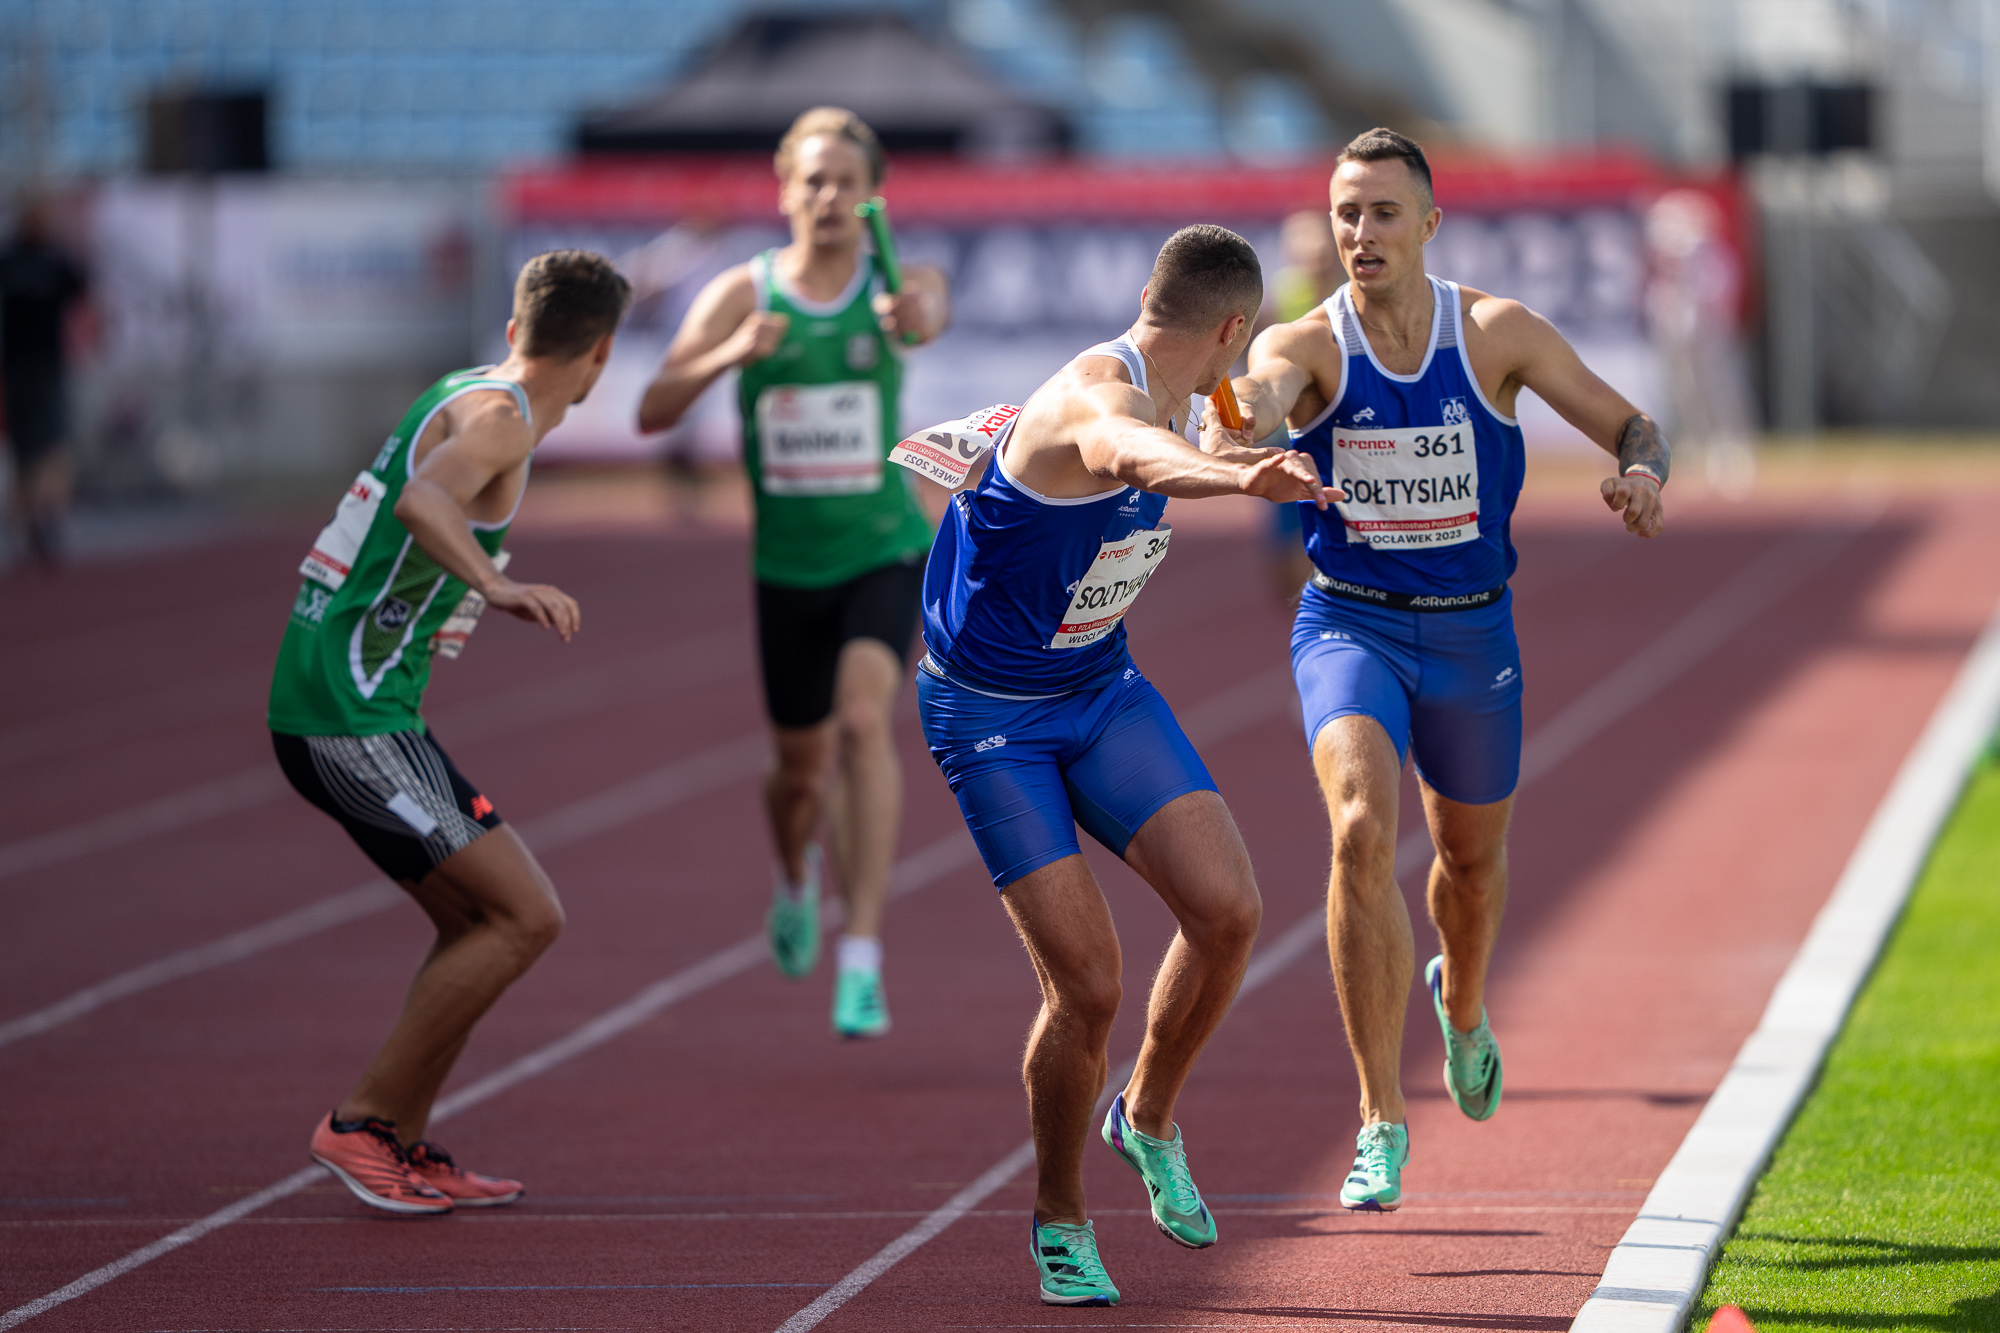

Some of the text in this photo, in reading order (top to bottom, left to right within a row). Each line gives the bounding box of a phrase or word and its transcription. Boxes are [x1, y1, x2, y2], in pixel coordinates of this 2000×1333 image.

[1348, 439, 1396, 450] renex
[1413, 432, 1465, 458] 361
[1341, 472, 1472, 506] SOŁTYSIAK
[1380, 519, 1430, 531] Mistrzostwa
[1431, 517, 1456, 529] Polski
[1436, 529, 1462, 542] 2023
[1409, 591, 1490, 608] AdRunaLine
